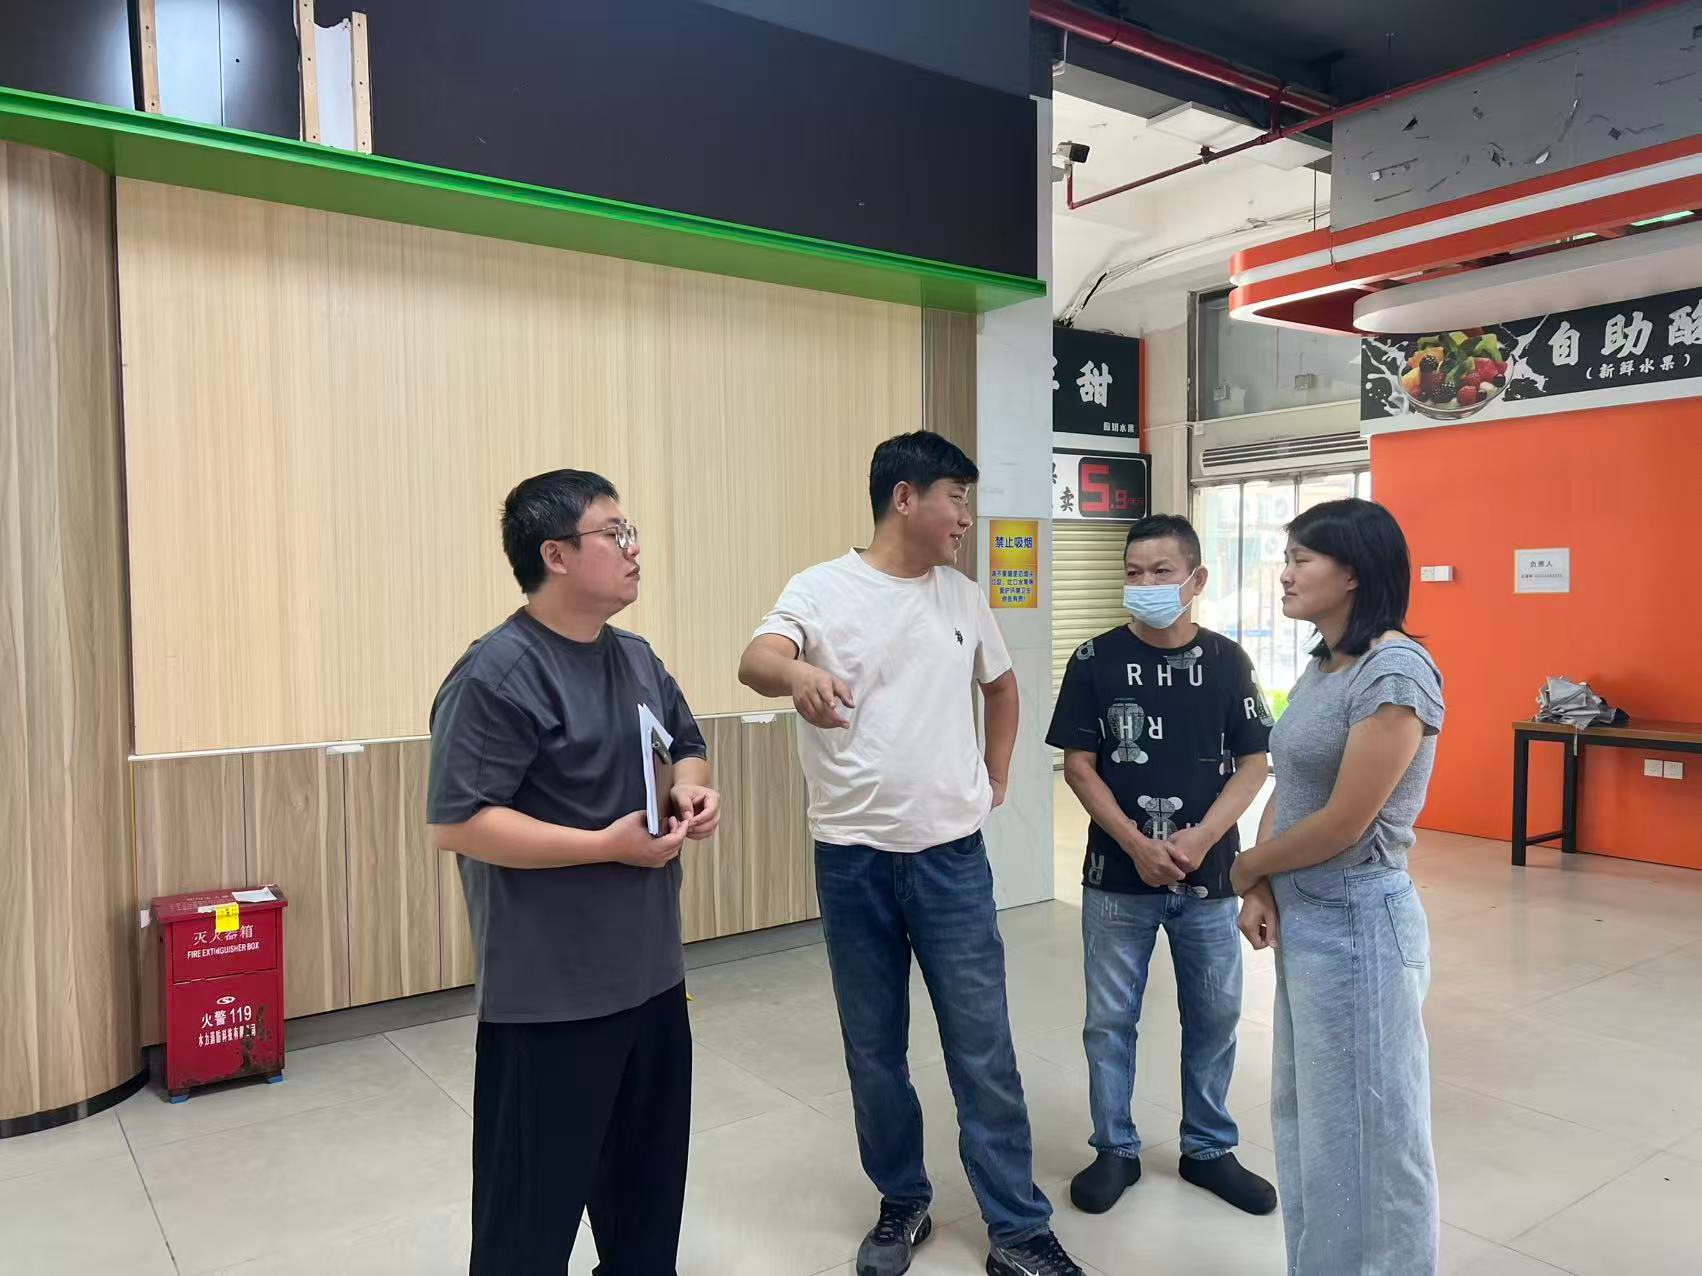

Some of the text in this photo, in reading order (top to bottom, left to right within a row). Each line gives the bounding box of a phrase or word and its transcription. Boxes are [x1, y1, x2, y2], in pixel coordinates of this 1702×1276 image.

[994, 536, 1033, 548] 禁止吸烟
[187, 942, 260, 959] FIRE EXTINGUISHER BOX
